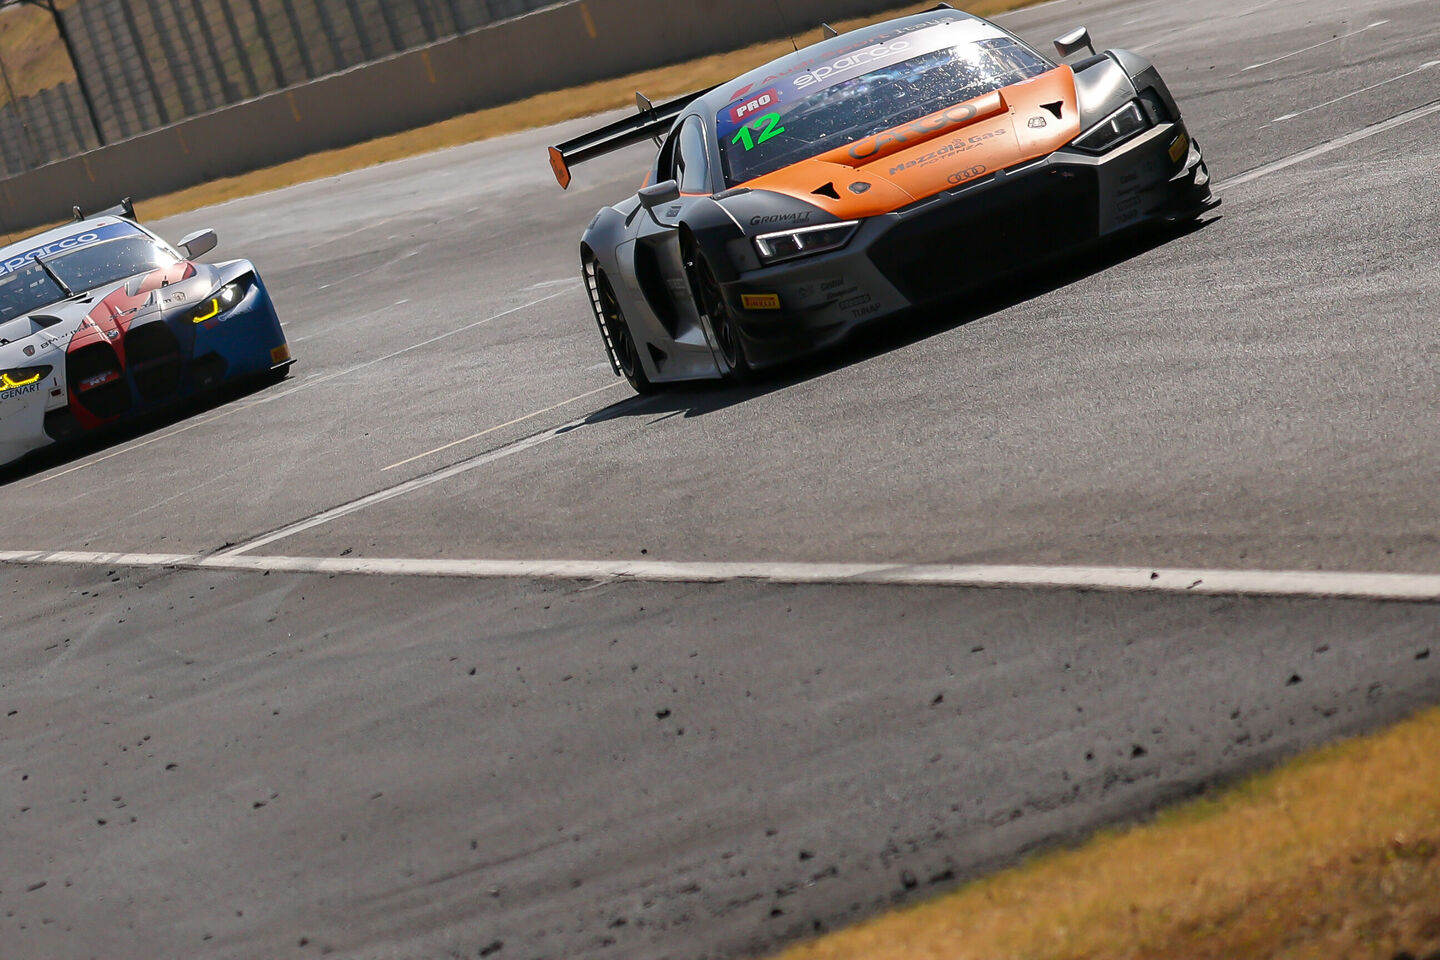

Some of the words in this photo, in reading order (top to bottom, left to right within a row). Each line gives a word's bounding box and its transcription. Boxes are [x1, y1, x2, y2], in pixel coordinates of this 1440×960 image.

[793, 39, 911, 89] sparco
[736, 93, 772, 118] PRO
[732, 112, 786, 152] 12
[968, 128, 1006, 144] Gas
[750, 211, 812, 226] GROWATT
[1, 383, 41, 401] GENART
